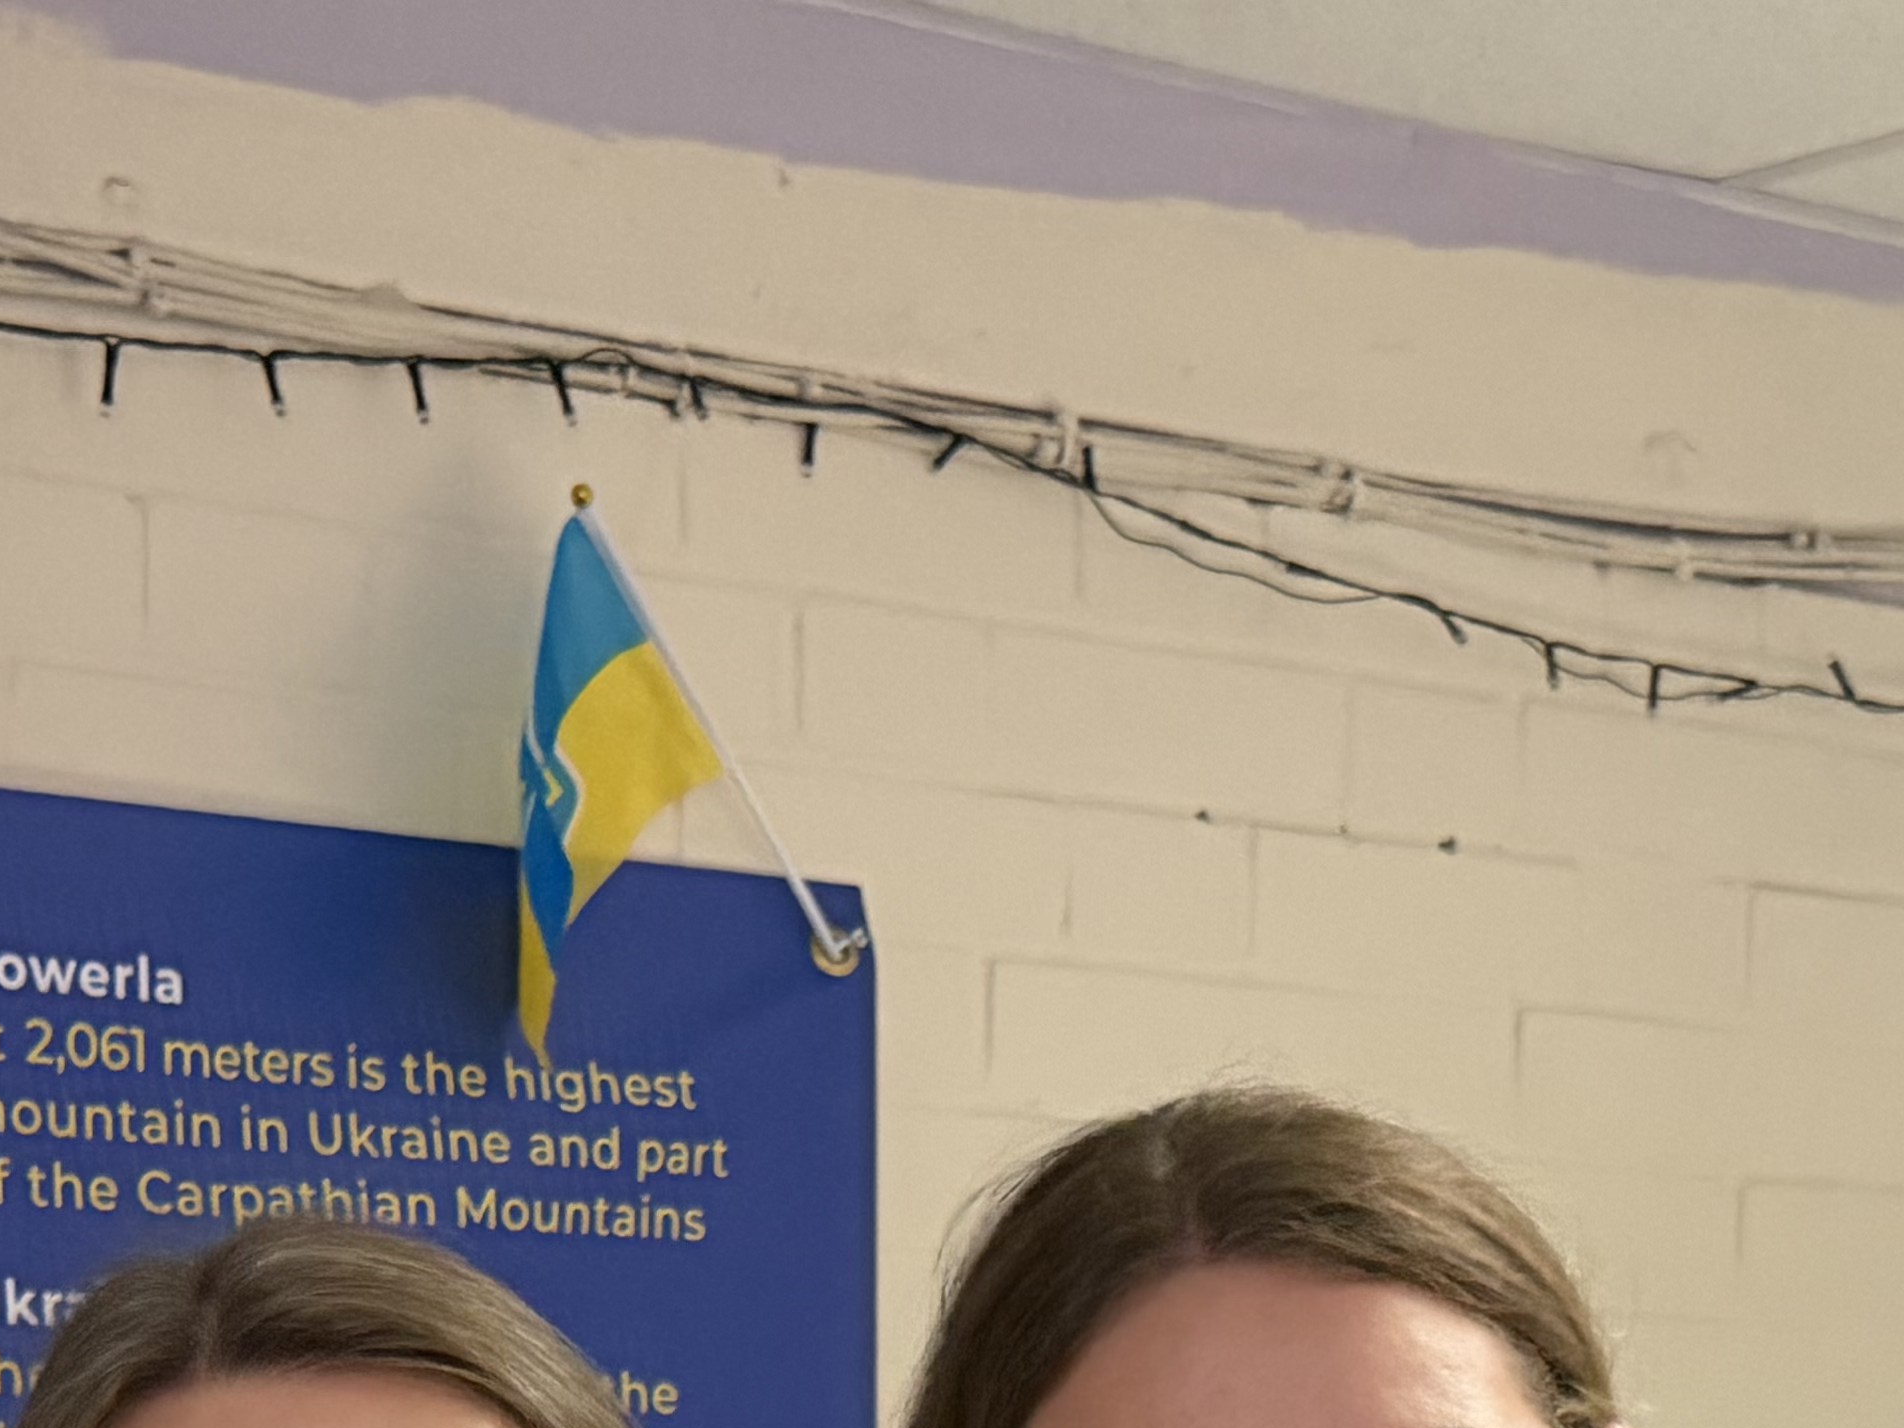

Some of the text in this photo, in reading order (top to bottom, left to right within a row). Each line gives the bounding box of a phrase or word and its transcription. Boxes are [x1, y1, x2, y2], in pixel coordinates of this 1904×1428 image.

[24, 1017, 146, 1075] 2,061
[163, 1041, 336, 1088] meters
[346, 1042, 387, 1092] is
[400, 1050, 488, 1098] the
[503, 1055, 698, 1114] highest
[240, 1103, 289, 1153] in
[308, 1110, 511, 1164] Ukraine
[528, 1125, 622, 1172] and
[636, 1137, 730, 1183] part
[26, 1160, 120, 1212] the
[136, 1167, 437, 1227] Carpathian
[455, 1184, 708, 1243] Mountains
[616, 1370, 680, 1416] he
